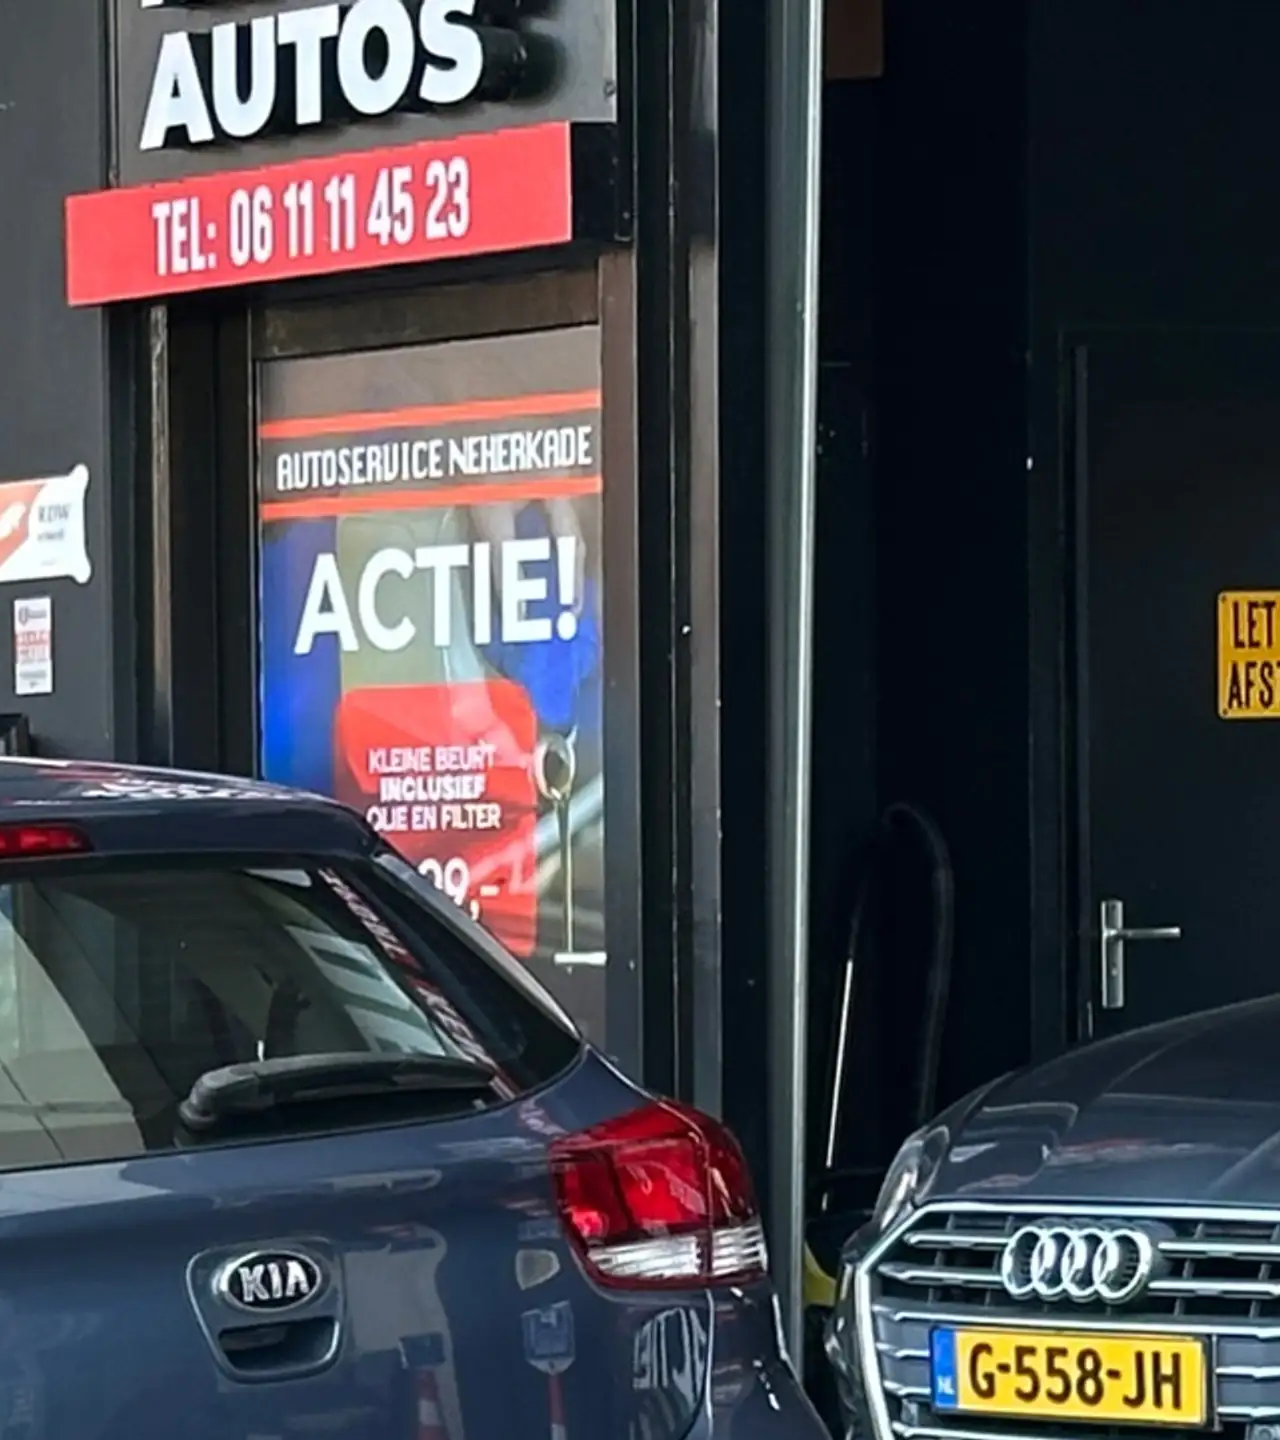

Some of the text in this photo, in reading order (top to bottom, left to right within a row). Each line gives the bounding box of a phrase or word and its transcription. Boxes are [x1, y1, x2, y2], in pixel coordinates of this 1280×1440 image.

[140, 0, 484, 150] AUTOS
[151, 158, 471, 276] TEL: 06 11 11 45 23
[276, 426, 593, 492] AUTOSERVICE NEHERKADE
[294, 536, 578, 655] ACTIE!
[1232, 599, 1276, 649] LET
[1228, 659, 1280, 710] AFS
[367, 743, 496, 774] KLEINE BEURT
[379, 774, 487, 802] INCLUSIEF
[411, 804, 437, 831] EN
[441, 802, 502, 831] FILTER
[239, 1259, 310, 1303] KIA
[969, 1343, 1182, 1411] G-558-JH
